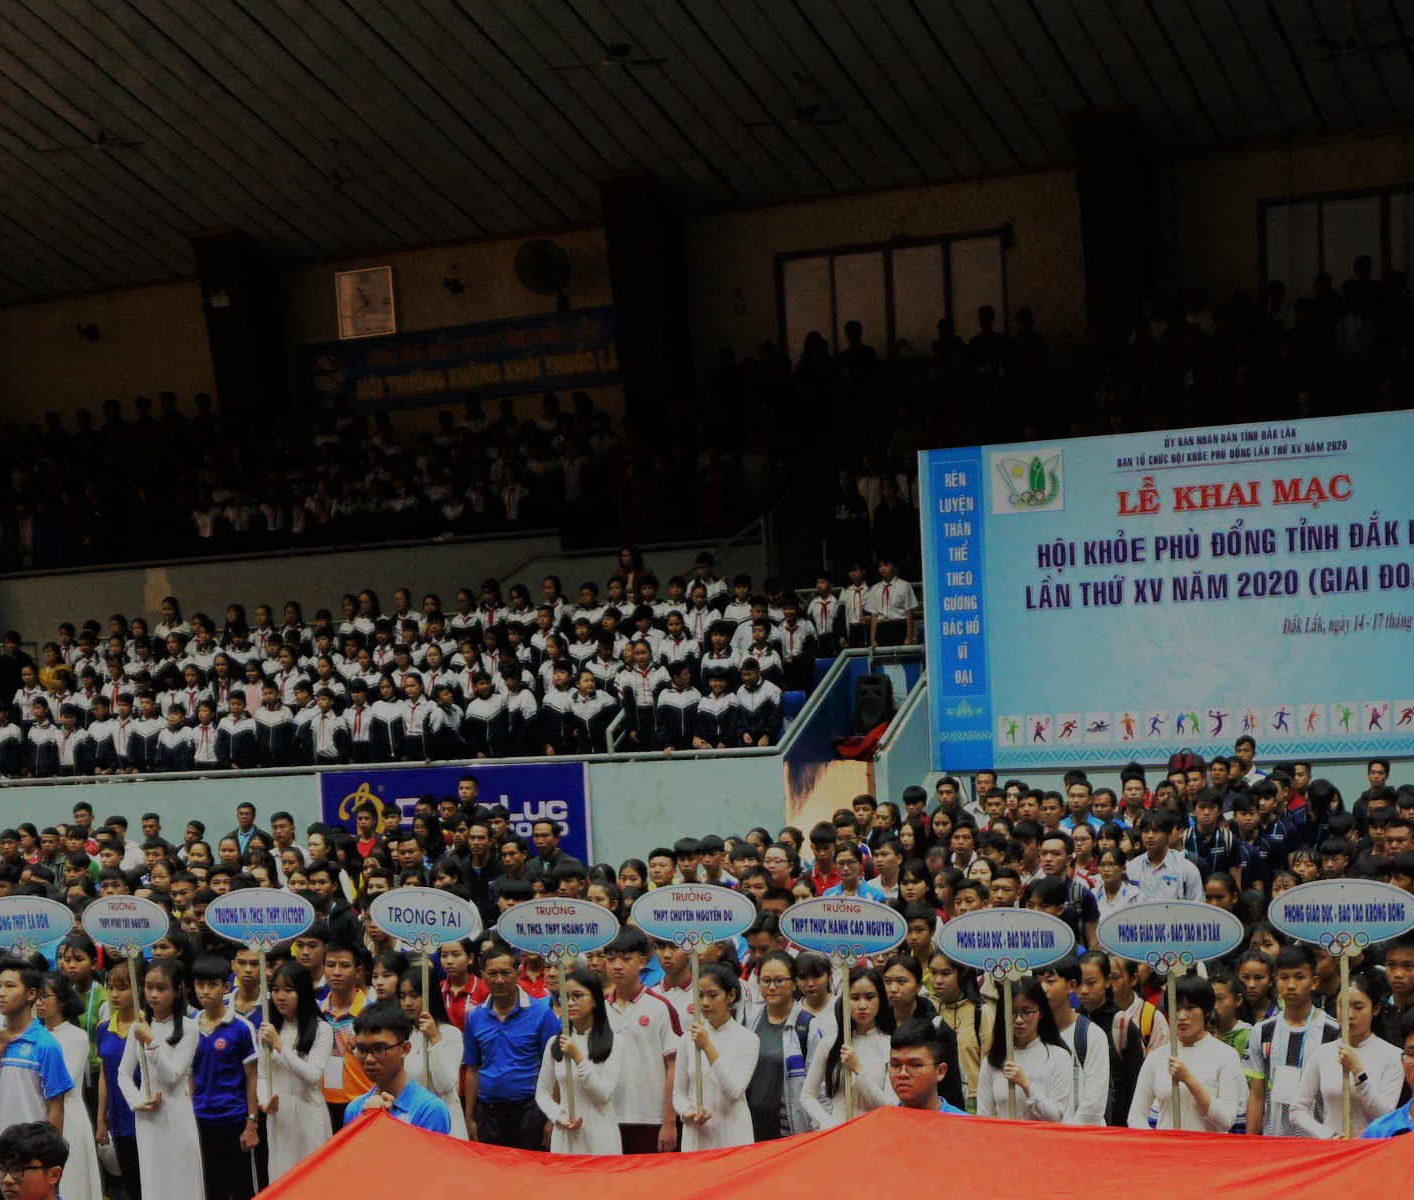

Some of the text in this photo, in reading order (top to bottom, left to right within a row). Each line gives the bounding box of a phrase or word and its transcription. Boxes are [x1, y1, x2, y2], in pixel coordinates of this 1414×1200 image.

[1178, 436, 1194, 446] BAN
[1197, 433, 1218, 445] NHÂN
[1221, 432, 1238, 444] DÂN
[1117, 457, 1133, 468] BAN
[1171, 452, 1185, 465] HỘI
[1290, 443, 1302, 454] XV
[1304, 441, 1325, 453] NĂM
[1326, 440, 1348, 451] 2020
[944, 470, 966, 487] RÈN
[1117, 474, 1353, 516] LỄ KHAI MẠC
[939, 496, 973, 514] LUYỆN
[943, 521, 971, 537] THÂN
[1038, 535, 1076, 573] HỘI
[1084, 529, 1146, 565] KHỎE
[1154, 528, 1199, 560] PHÙ
[1211, 518, 1276, 557] ĐỔNG
[1285, 517, 1339, 552] TỈNH
[1349, 511, 1399, 549] ĐẮK
[948, 542, 968, 561] THỂ
[946, 571, 972, 587] THEO
[1025, 575, 1071, 611] LẦN
[1079, 575, 1124, 606] THỨ
[1134, 577, 1163, 604] XV
[1172, 571, 1228, 601] NĂM
[1237, 570, 1298, 599] 2020
[1308, 565, 1368, 596] (GIAI
[943, 595, 977, 611] GƯƠNG
[943, 616, 979, 636] BÁC HỒ
[1328, 617, 1350, 637] ngày
[1353, 613, 1364, 630] 14
[1372, 612, 1384, 629] 17
[1385, 610, 1412, 632] tháng
[957, 642, 968, 660] VĨ
[954, 670, 972, 687] ĐẠI
[281, 907, 304, 923] VICTORY
[388, 906, 461, 927] TRỌNG TÀI
[653, 909, 667, 922] THPT
[545, 923, 560, 934] THPT
[792, 918, 808, 932] THPT
[850, 920, 864, 935] CAO
